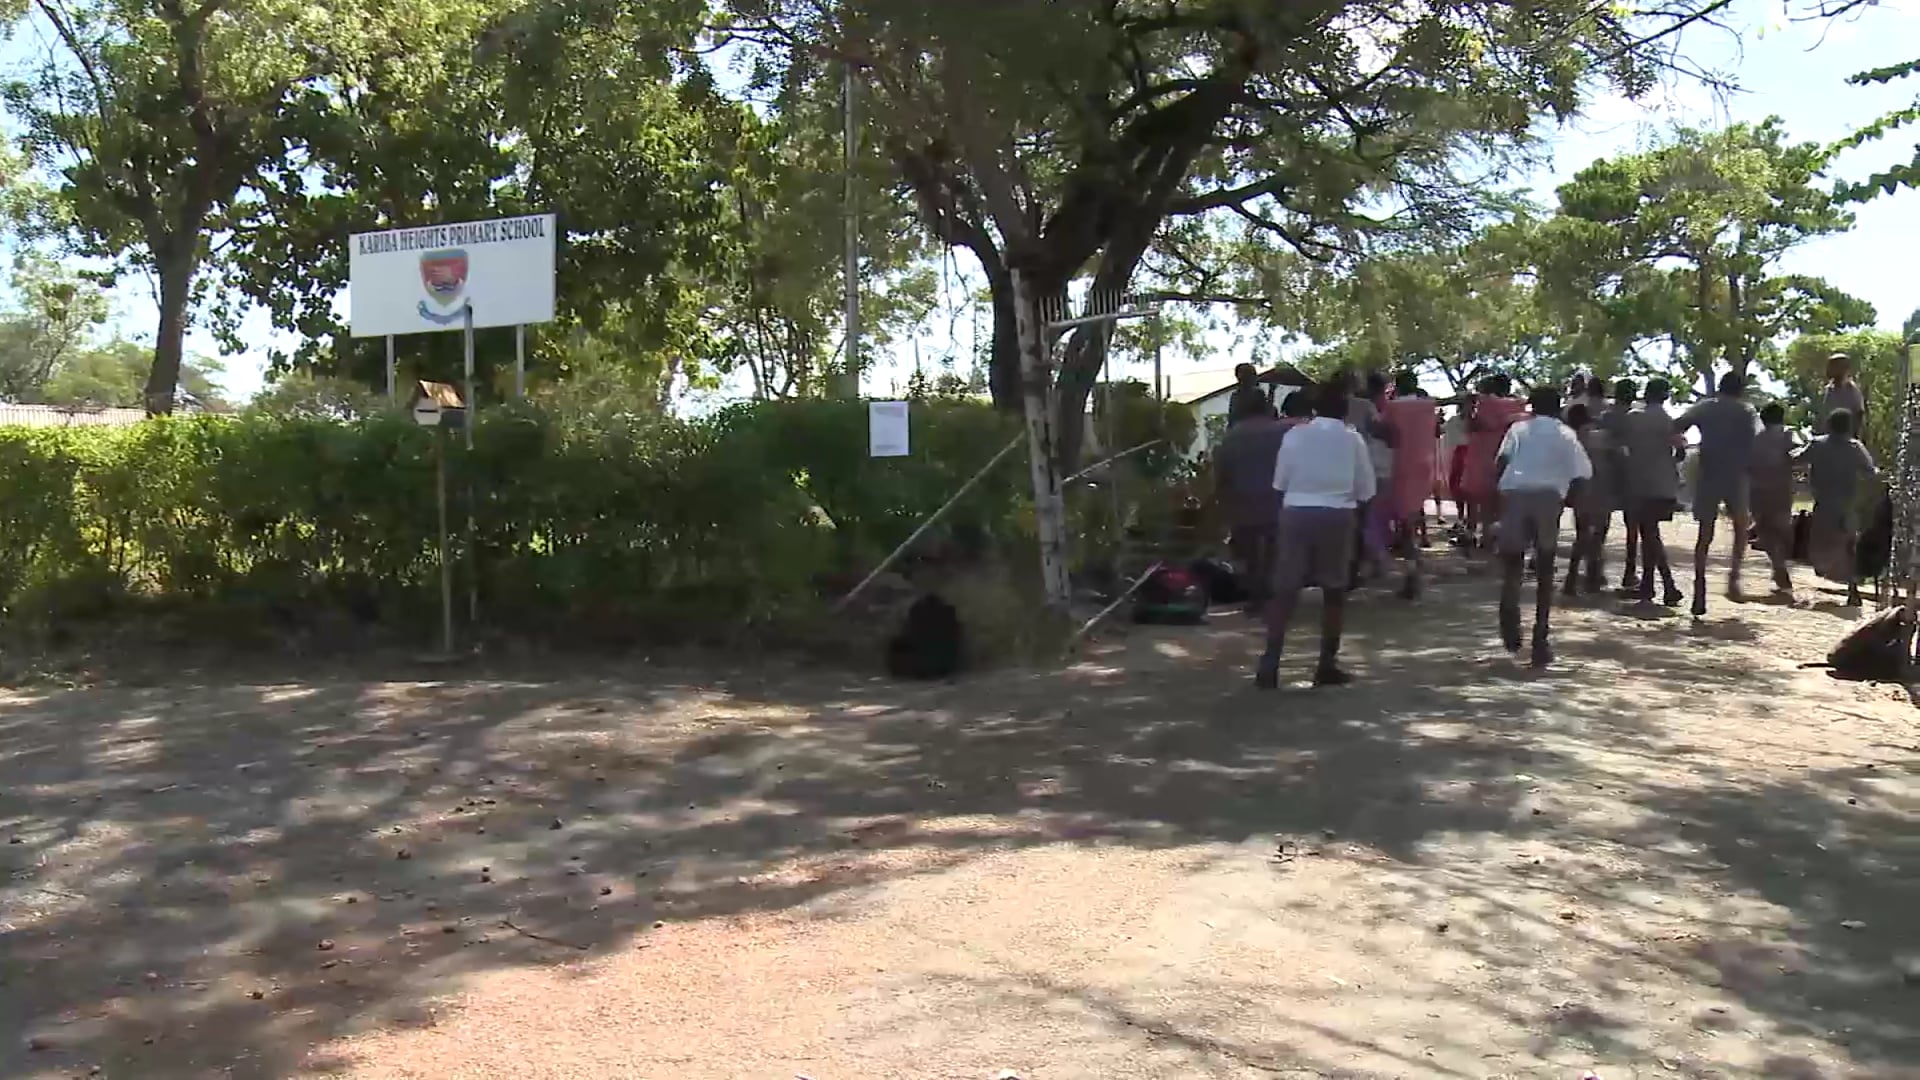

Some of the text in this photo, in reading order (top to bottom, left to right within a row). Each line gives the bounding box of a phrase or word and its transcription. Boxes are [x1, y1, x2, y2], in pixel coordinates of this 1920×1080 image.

[358, 217, 545, 256] KARIBA HEIGHTS PRIMARY SCHOOL
